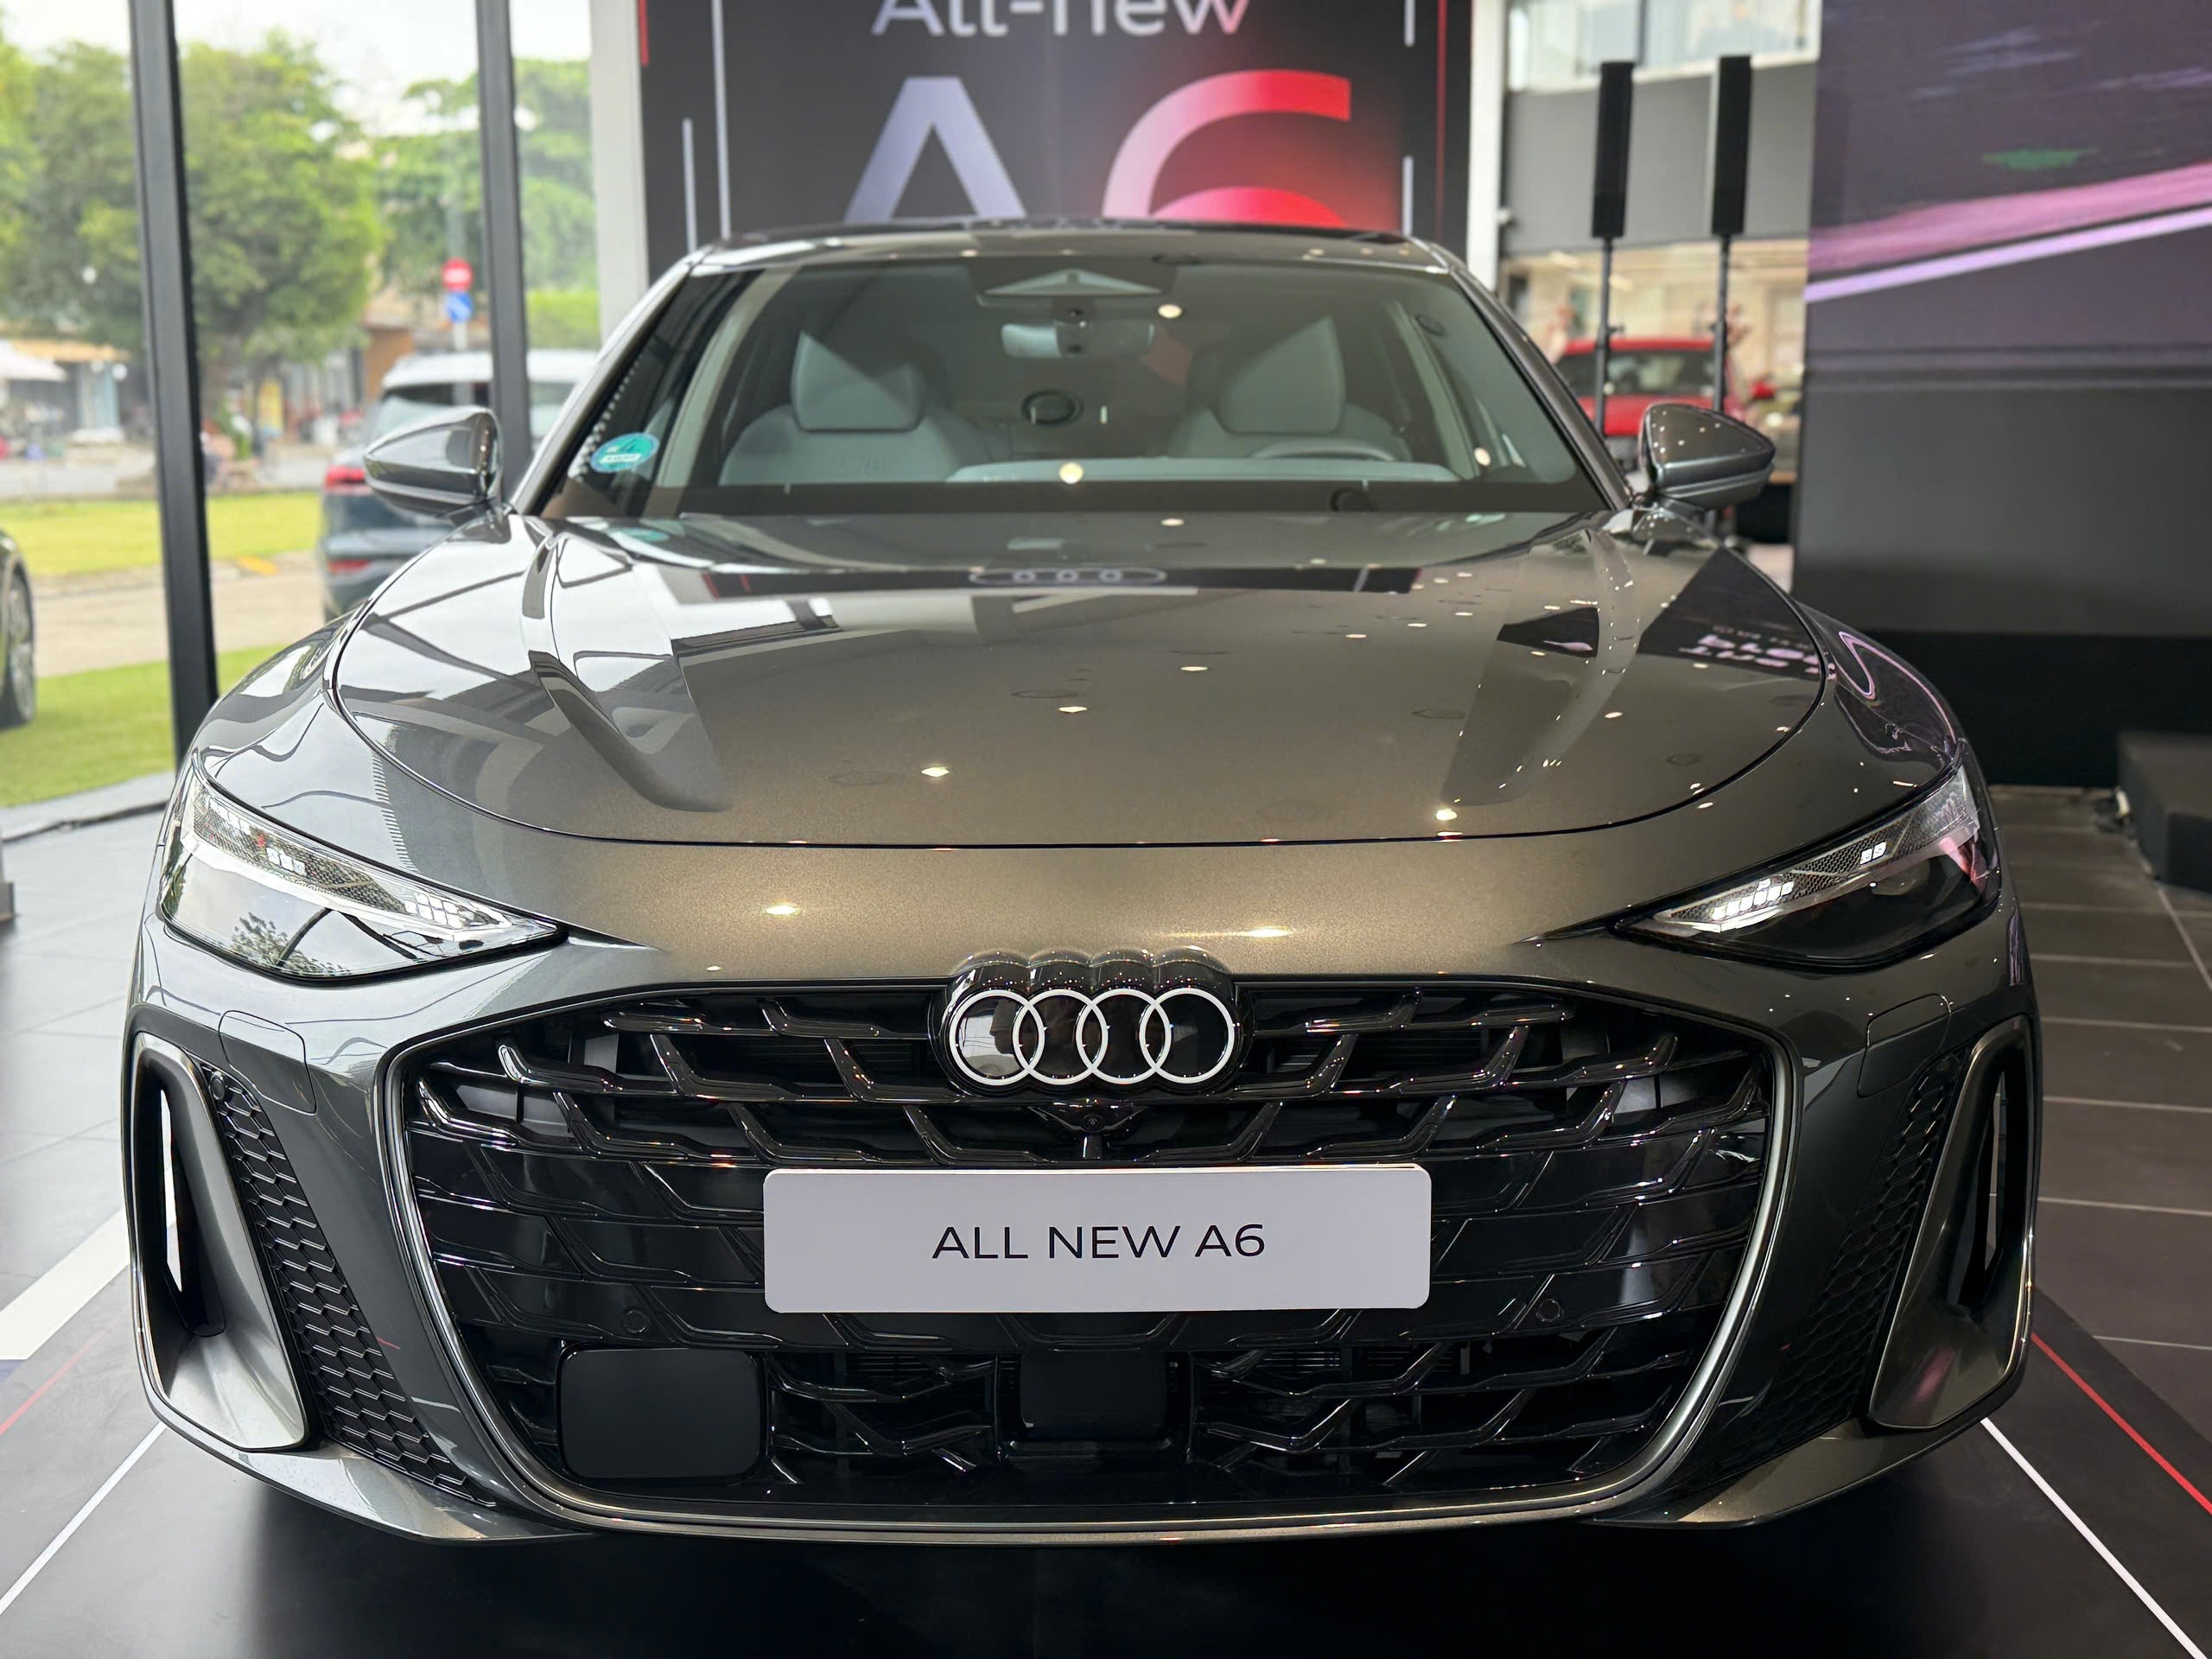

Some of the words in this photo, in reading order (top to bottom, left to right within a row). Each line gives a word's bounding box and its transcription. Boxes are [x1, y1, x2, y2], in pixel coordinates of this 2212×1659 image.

[873, 0, 1249, 36] All-new
[932, 1226, 1029, 1259] ALL
[1050, 1225, 1181, 1259] NEW
[1194, 1224, 1265, 1257] A6
